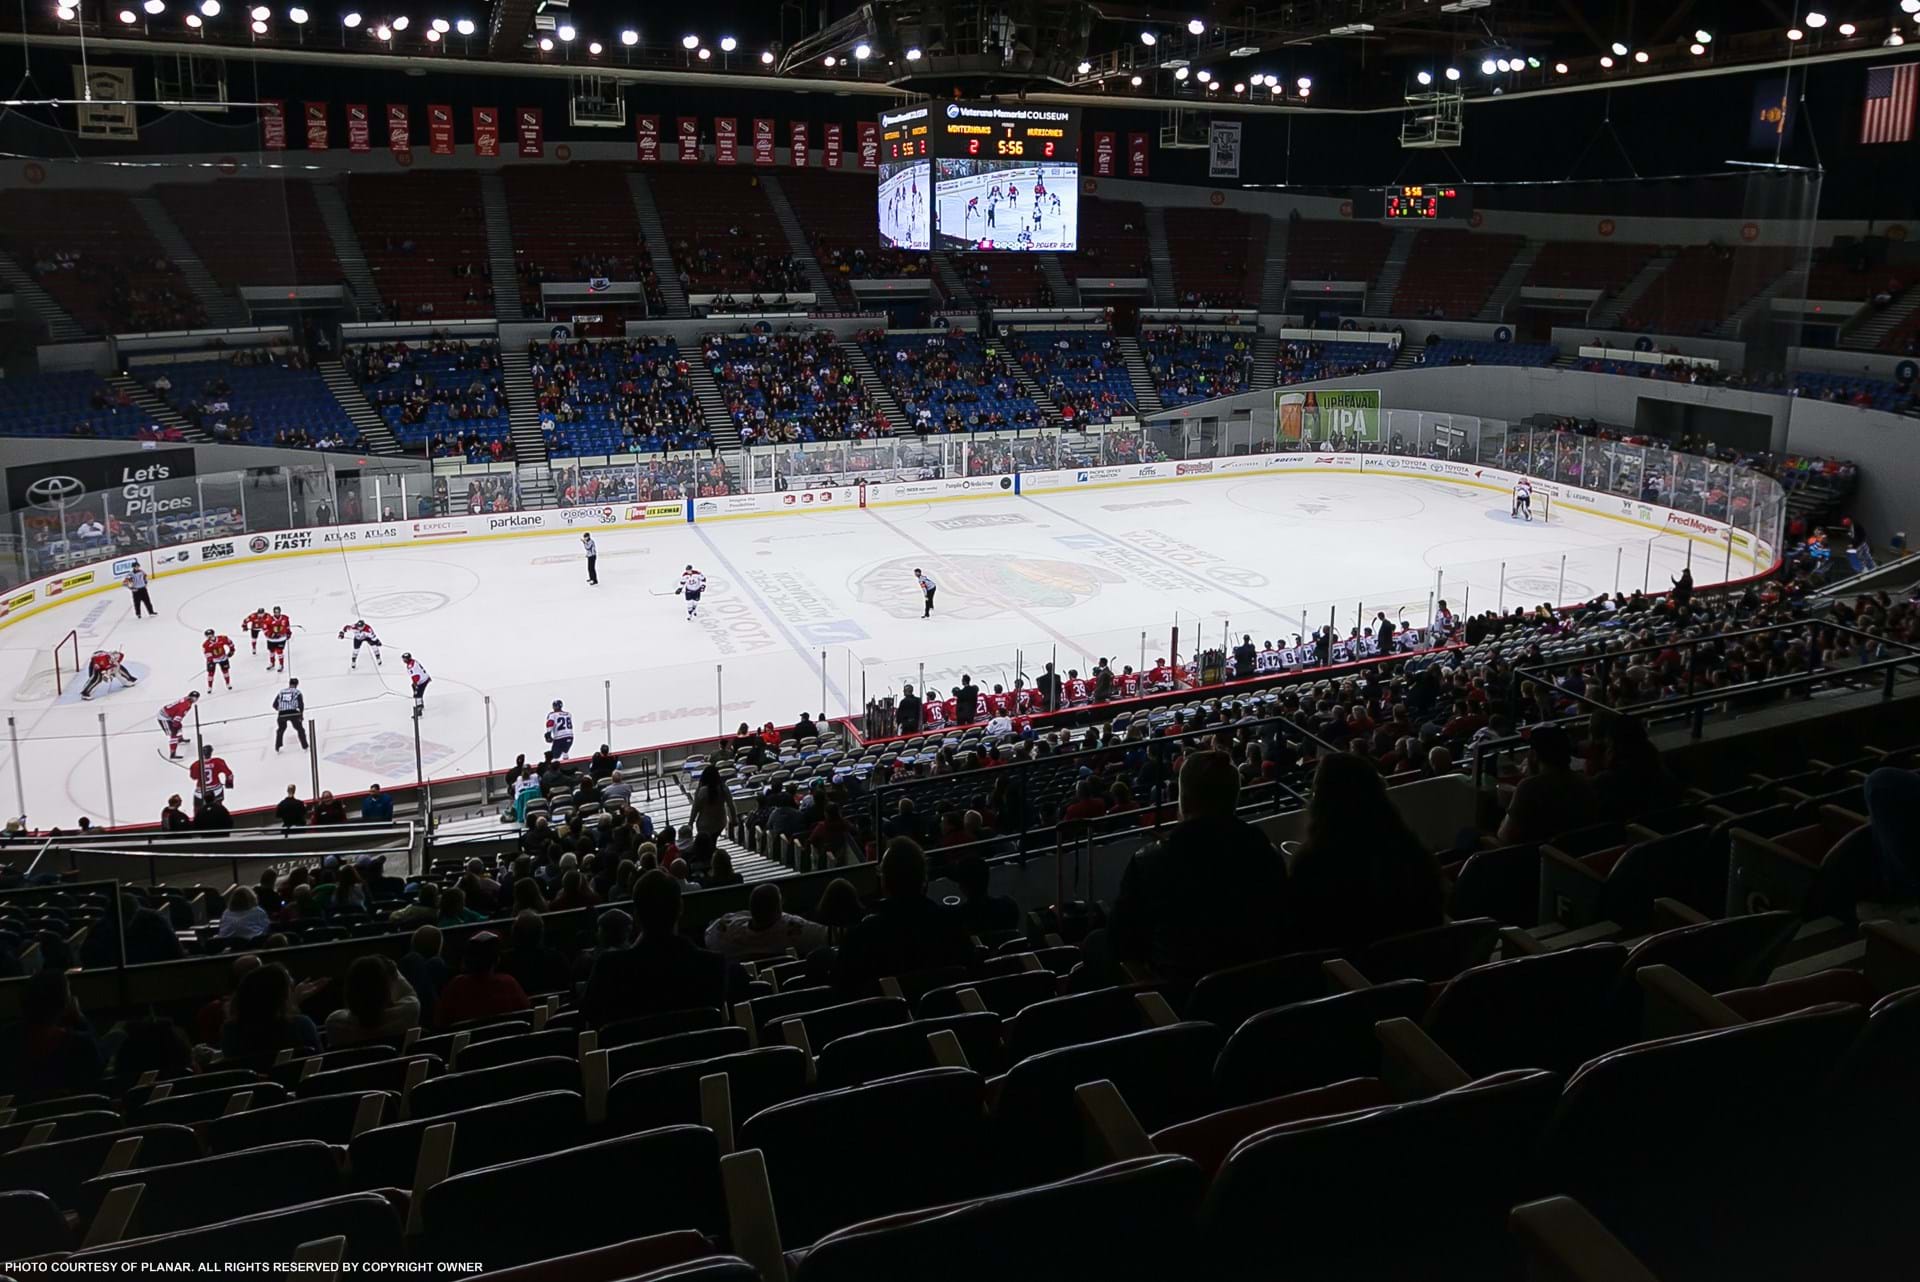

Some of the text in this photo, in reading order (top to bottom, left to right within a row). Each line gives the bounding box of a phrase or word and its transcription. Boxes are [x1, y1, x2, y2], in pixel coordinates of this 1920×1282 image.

[960, 107, 1069, 121] Veterans Memorial COLISEUM
[970, 140, 979, 154] 2
[998, 140, 1024, 155] 5:56
[1045, 142, 1054, 156] 2
[1324, 395, 1372, 409] UPHEAVAL
[1333, 409, 1367, 436] IPA
[122, 464, 169, 483] Let's
[1444, 464, 1470, 472] TOYOTA
[123, 484, 153, 499] Go
[126, 496, 192, 517] Places
[490, 515, 542, 530] parklane
[600, 515, 616, 524] 359
[275, 531, 312, 541] FREAKY
[324, 532, 357, 543] ATLAS
[365, 528, 397, 539] ATLAS
[202, 542, 233, 553] BASE
[274, 538, 312, 550] FAST!
[202, 548, 234, 559] CAMP
[712, 596, 777, 652] TOYOTA
[1267, 656, 1278, 667] 17
[931, 706, 942, 720] 16
[976, 700, 988, 713] 21
[1558, 895, 1571, 918] F
